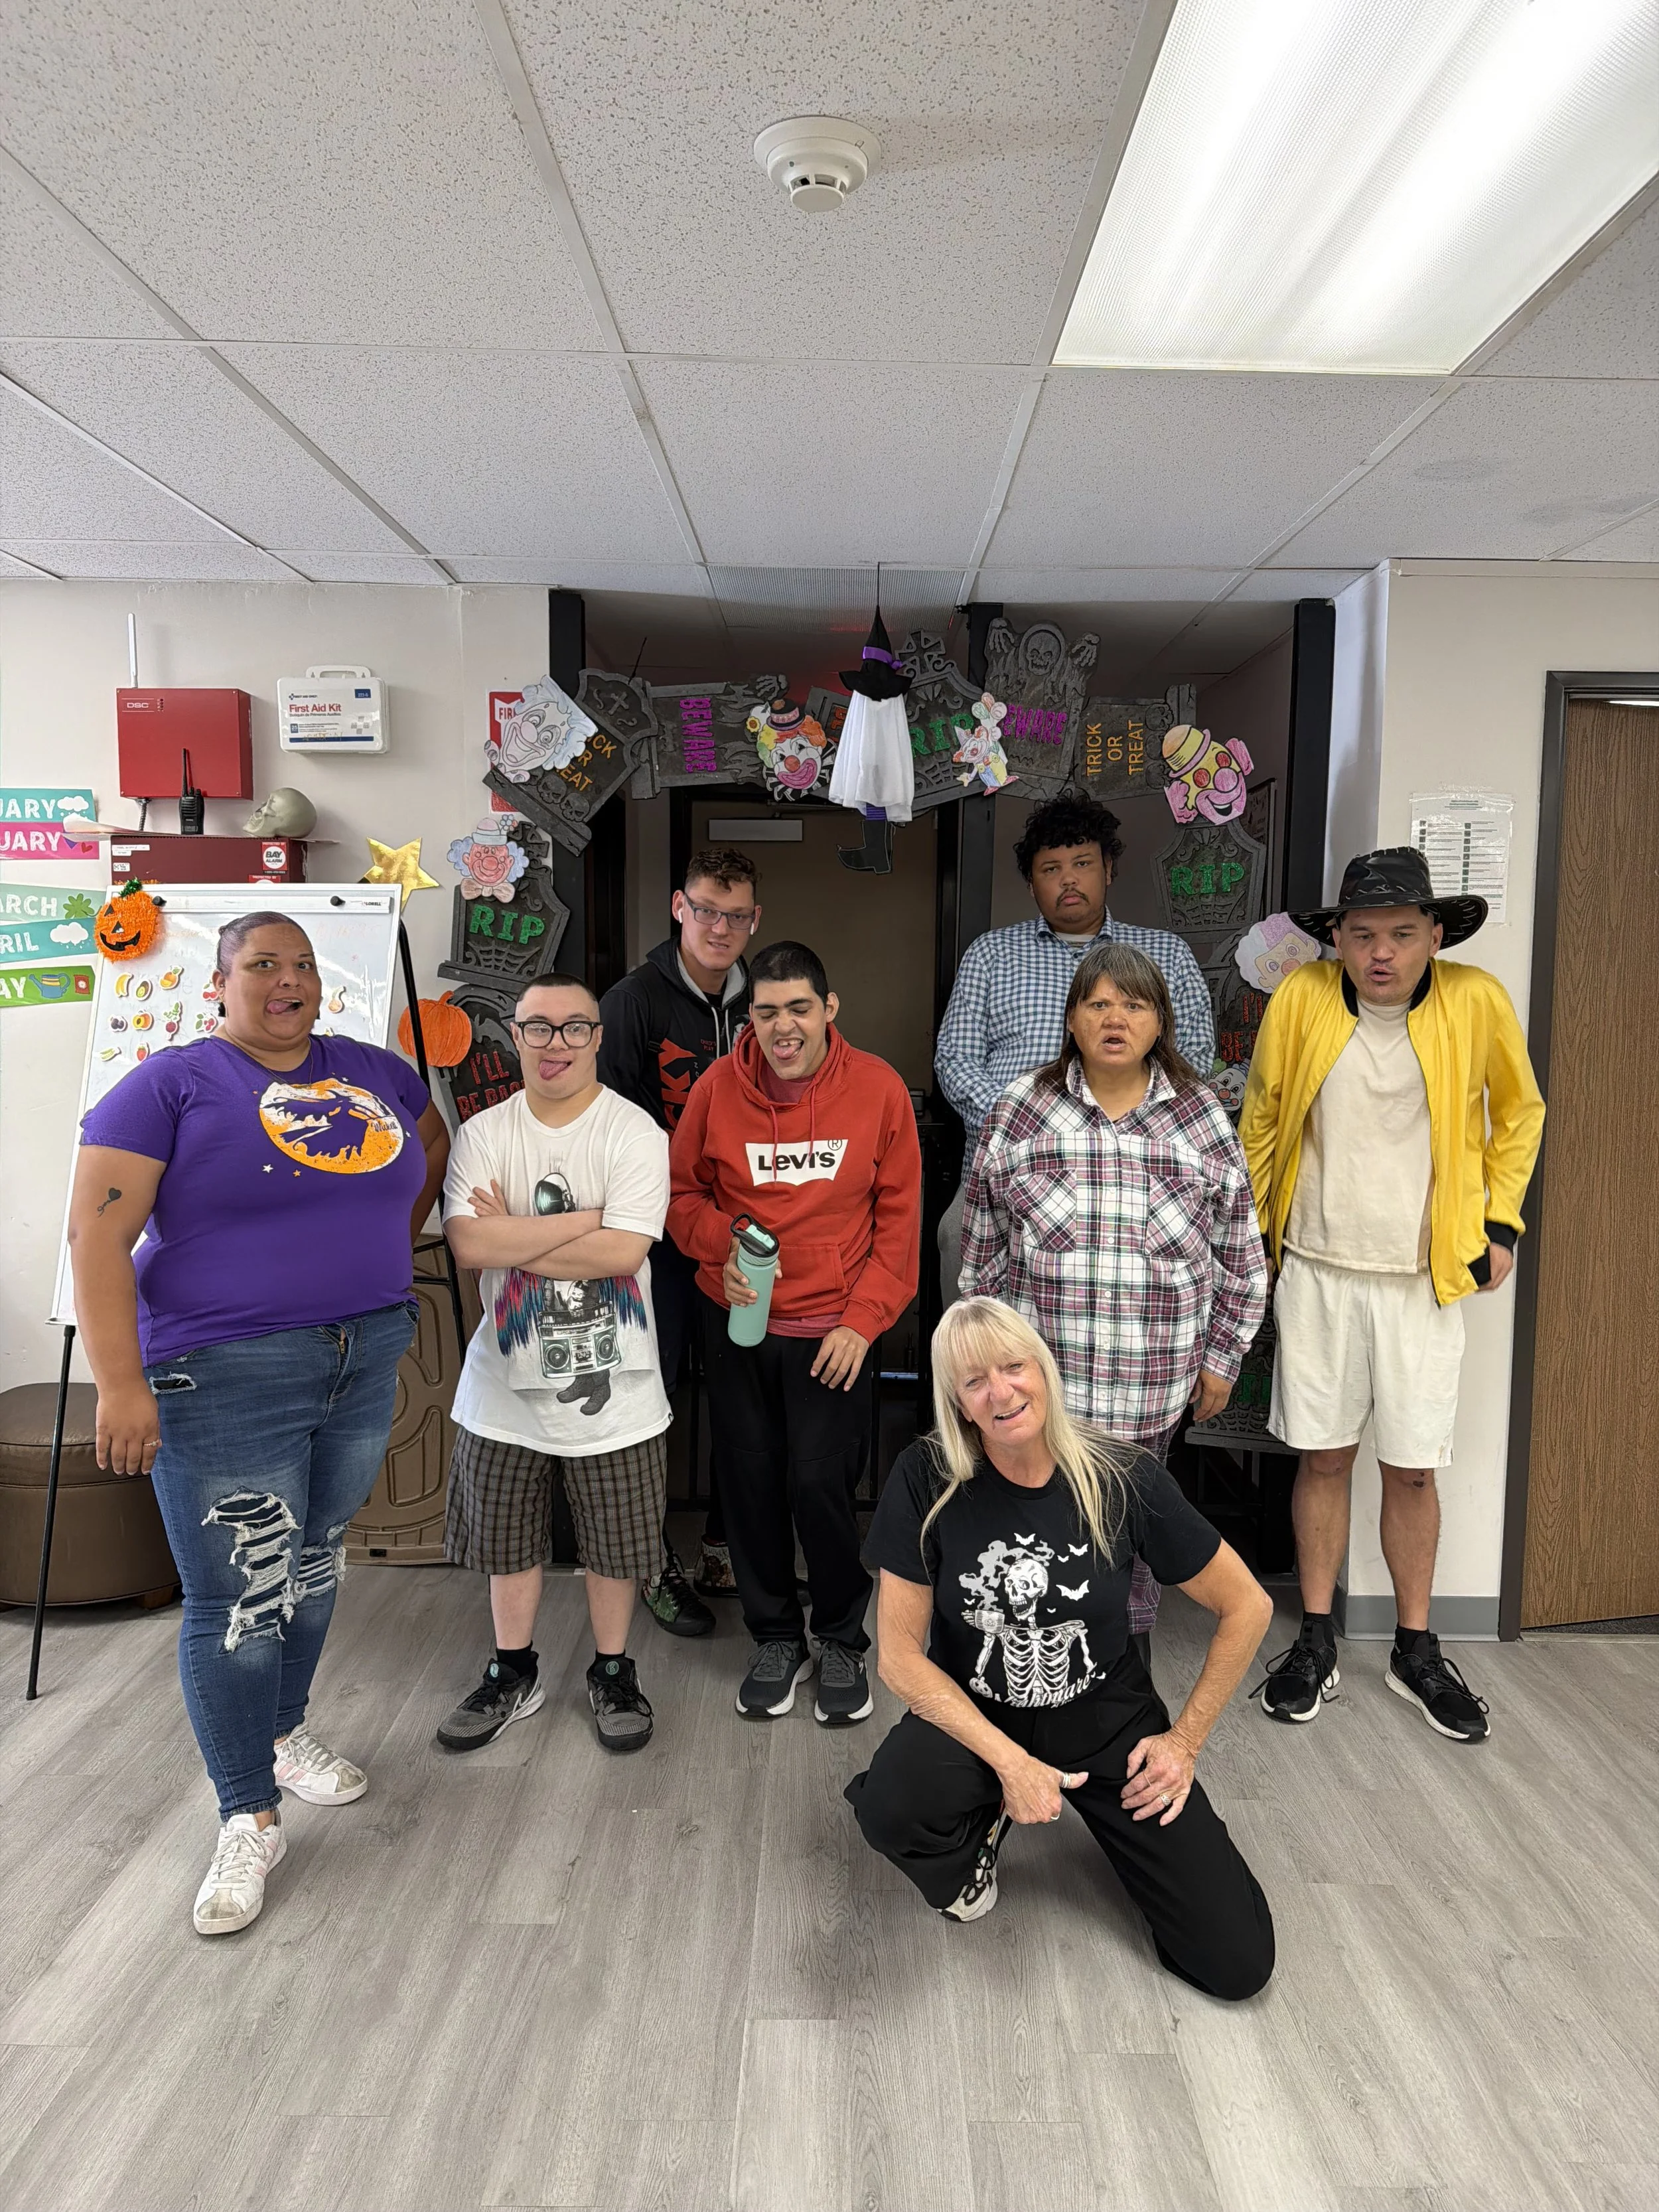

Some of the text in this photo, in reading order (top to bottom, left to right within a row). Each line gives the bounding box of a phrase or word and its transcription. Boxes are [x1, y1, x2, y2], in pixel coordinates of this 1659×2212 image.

[289, 703, 342, 713] First Aid Kit
[1001, 703, 1068, 745] EWARE
[680, 698, 717, 773] BEWARE
[1086, 723, 1102, 776] TRICK
[1107, 736, 1123, 761] OR
[1128, 719, 1143, 775] TREAT
[1171, 862, 1245, 897] RIP
[469, 904, 545, 944] RIP
[1220, 1031, 1245, 1062] BE
[470, 1051, 510, 1085] I'LL
